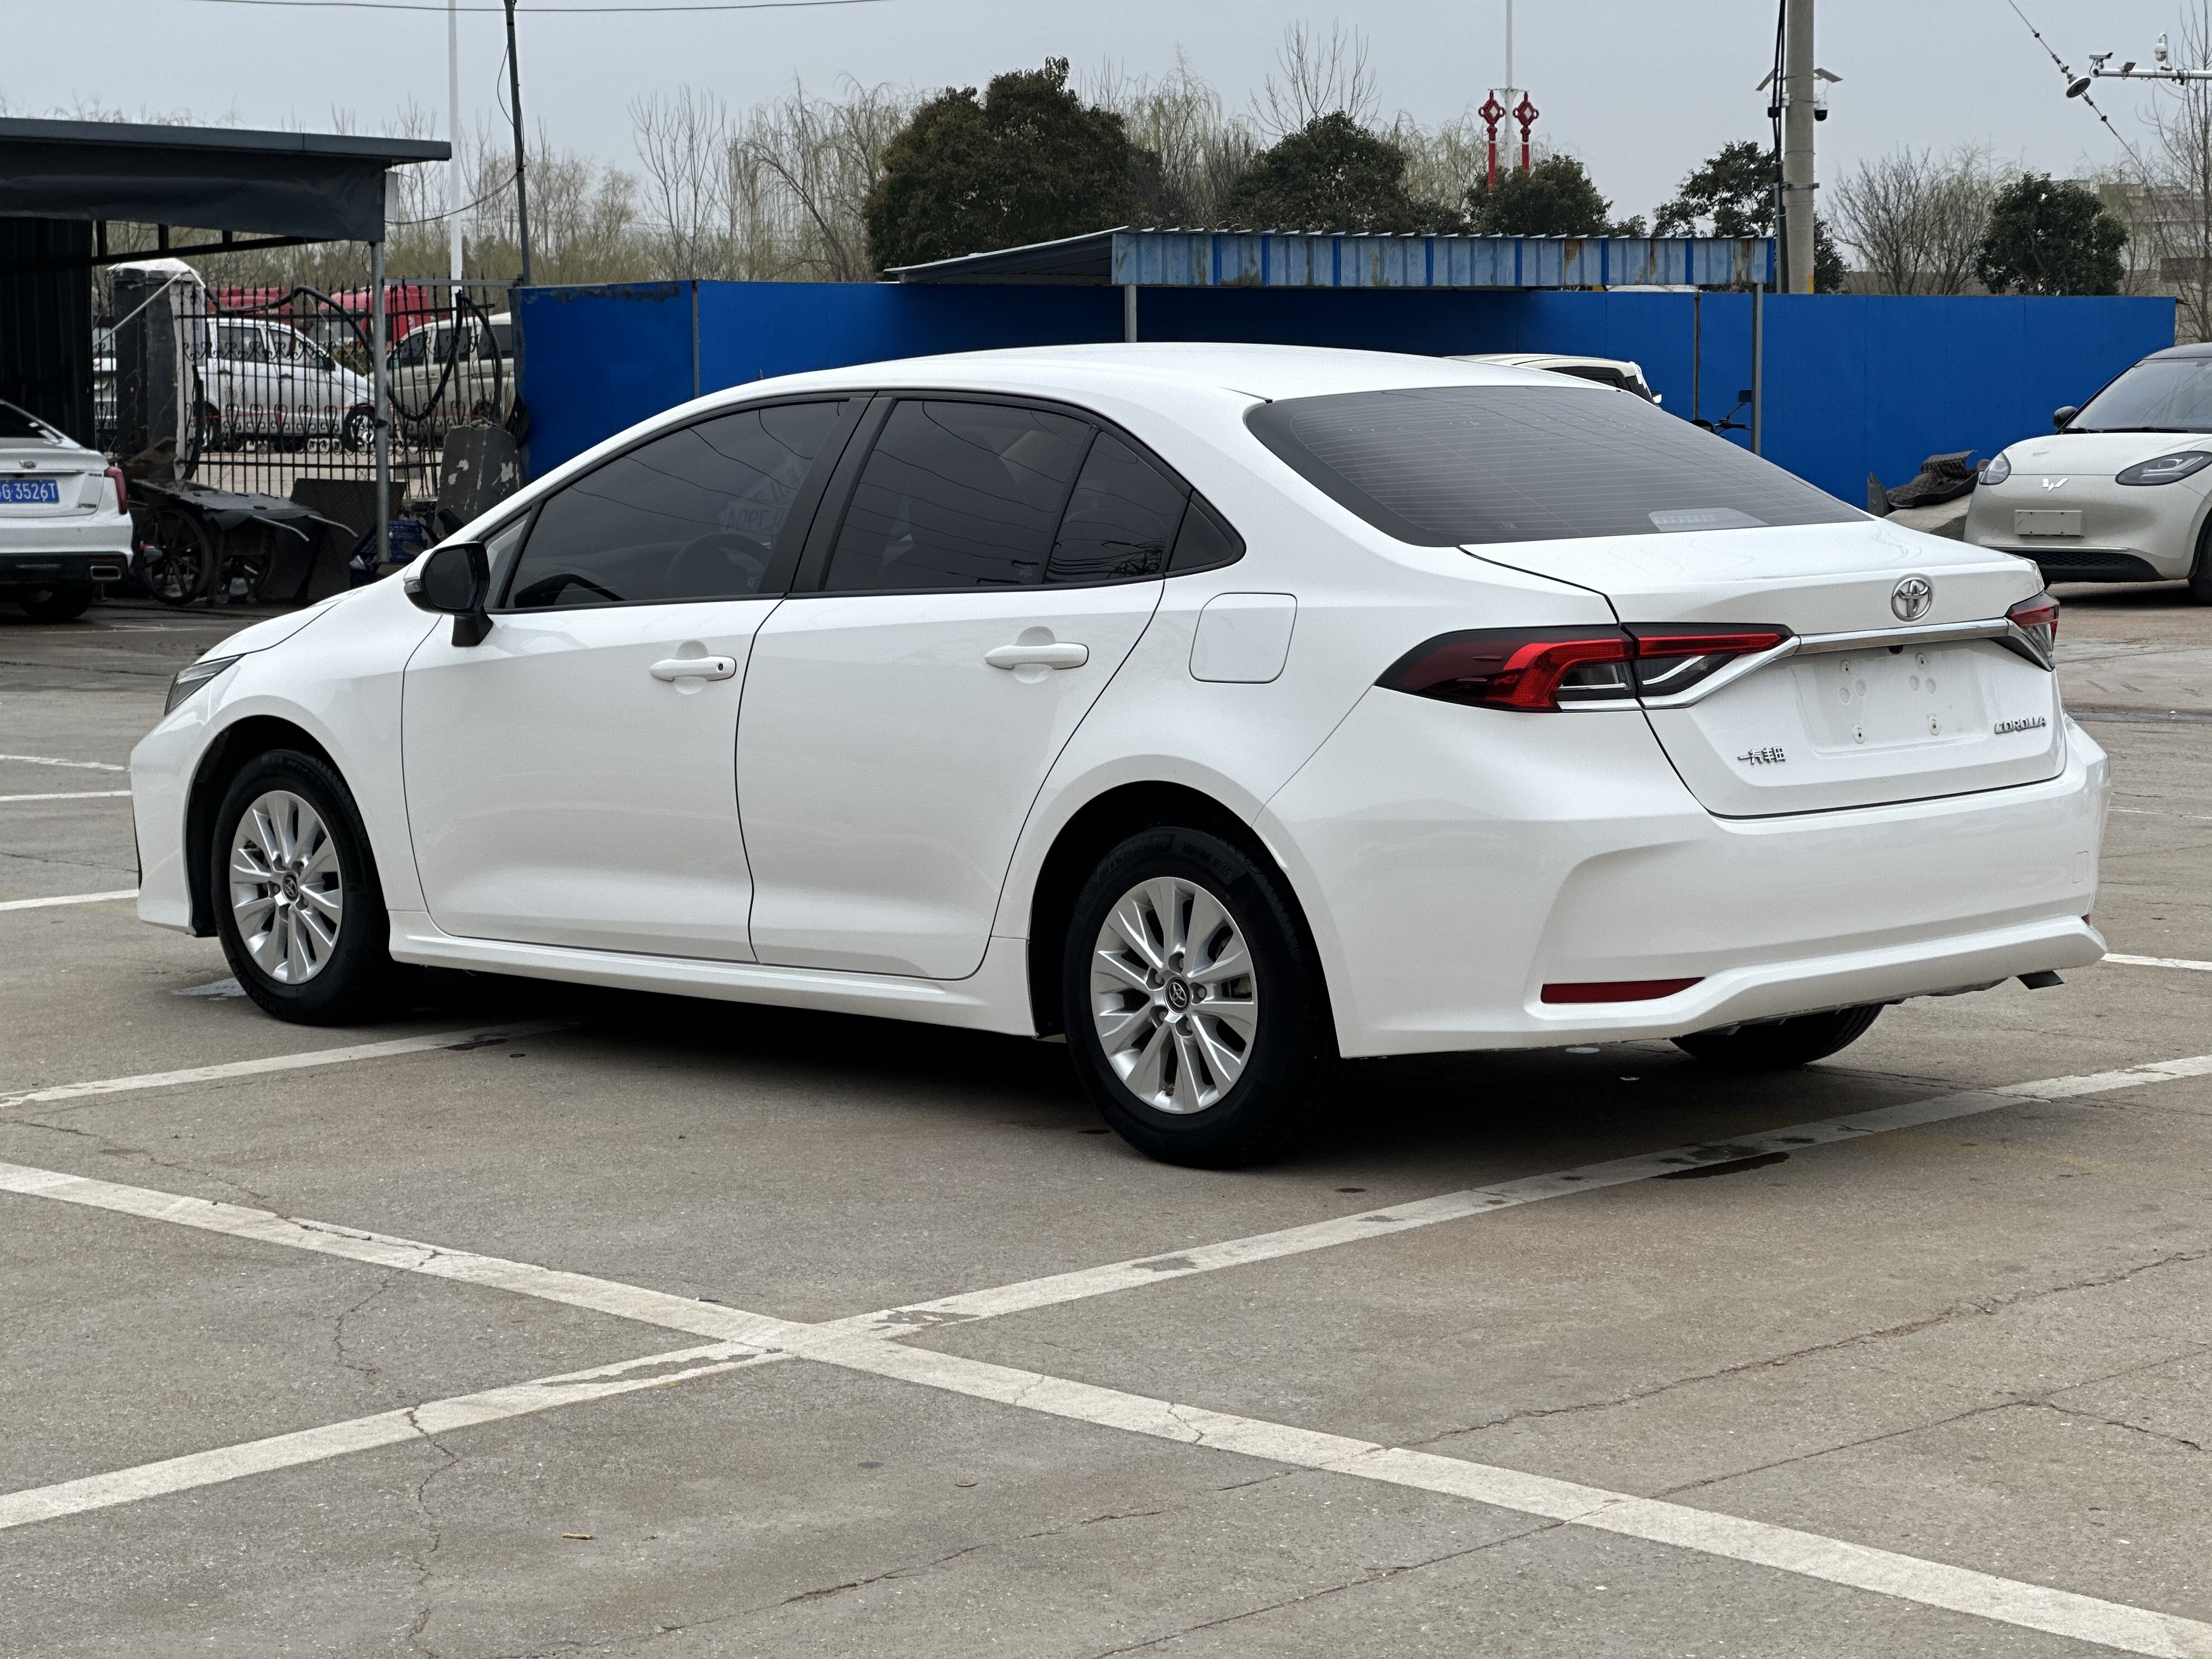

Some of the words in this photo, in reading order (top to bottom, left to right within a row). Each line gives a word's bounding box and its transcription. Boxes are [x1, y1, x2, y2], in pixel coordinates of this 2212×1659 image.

[0, 483, 55, 500] G·3526T
[1994, 716, 2046, 734] COROLLA
[1737, 747, 1786, 765] 一汽丰田
